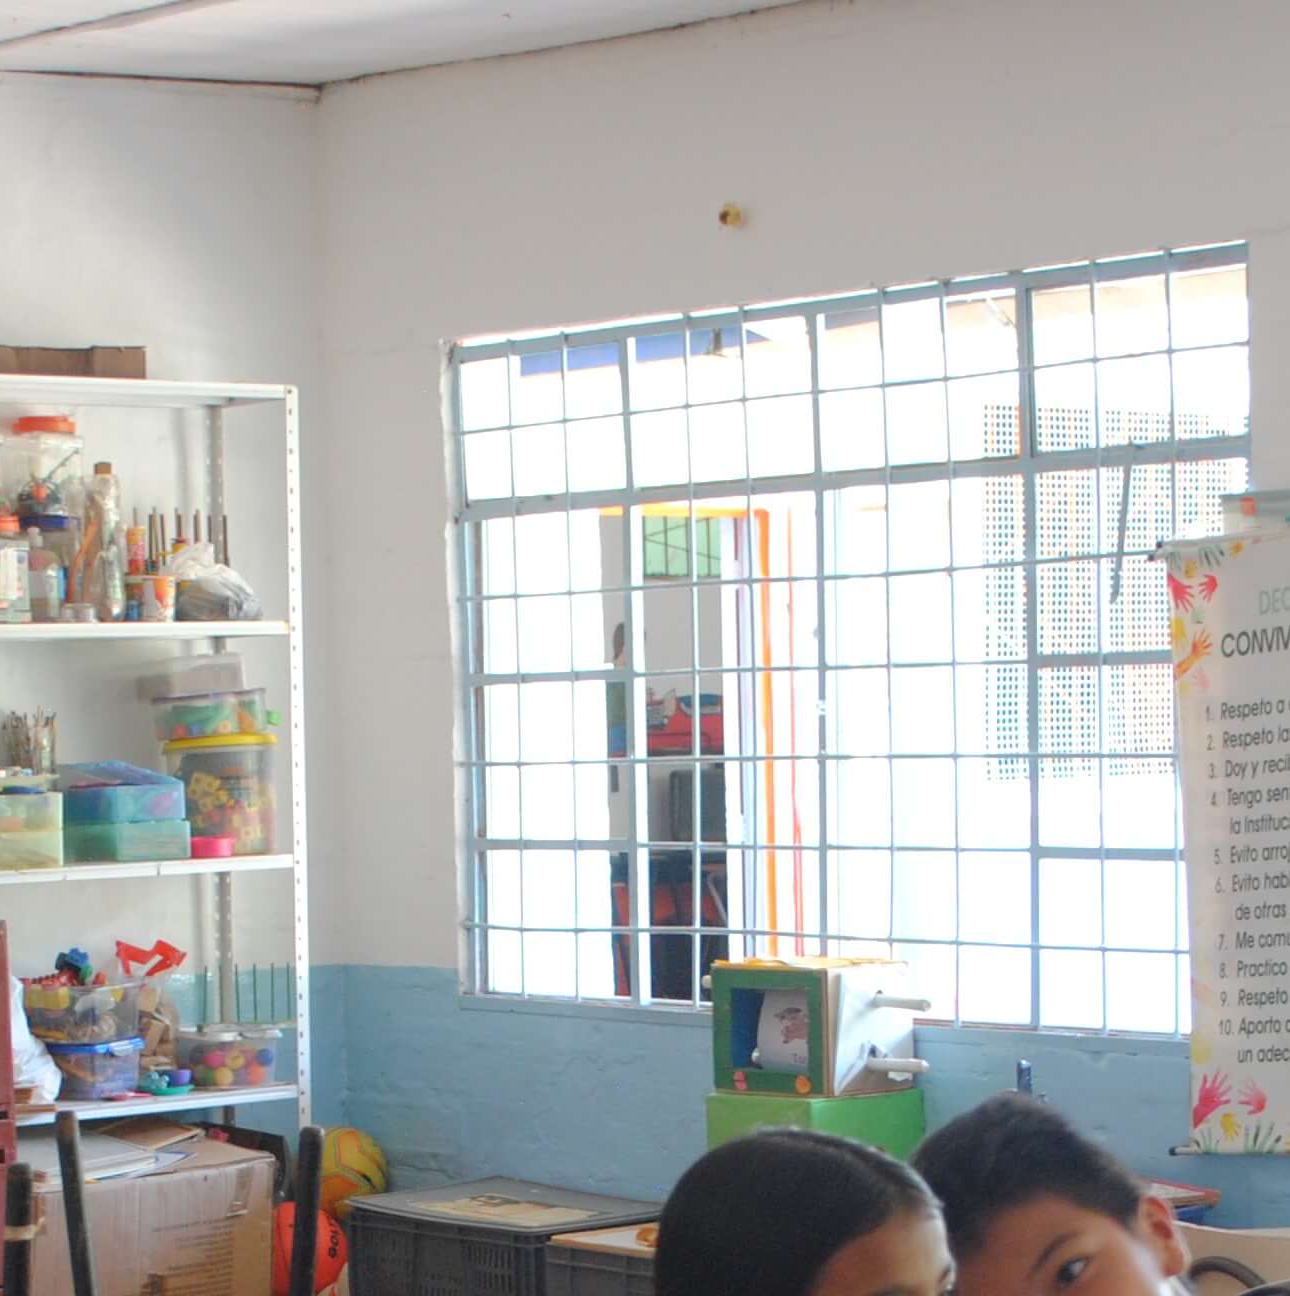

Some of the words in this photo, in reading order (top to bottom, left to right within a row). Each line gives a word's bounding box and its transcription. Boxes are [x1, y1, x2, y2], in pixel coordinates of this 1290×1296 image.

[1220, 698, 1272, 721] Respeto
[1276, 699, 1285, 714] a
[1222, 727, 1274, 751] Respeto
[1224, 759, 1248, 780] Doy
[1250, 760, 1259, 780] y
[1226, 787, 1263, 809] Tengo
[1229, 816, 1241, 835] la
[1229, 844, 1258, 864] Evito
[1231, 872, 1260, 893] Evito
[1235, 902, 1251, 921] de
[1254, 900, 1287, 919] otras
[1235, 930, 1255, 949] Me
[1236, 958, 1288, 979] Practico
[1237, 986, 1289, 1008] Respeto
[1237, 1015, 1282, 1039] Aporto
[1237, 1048, 1253, 1063] un
